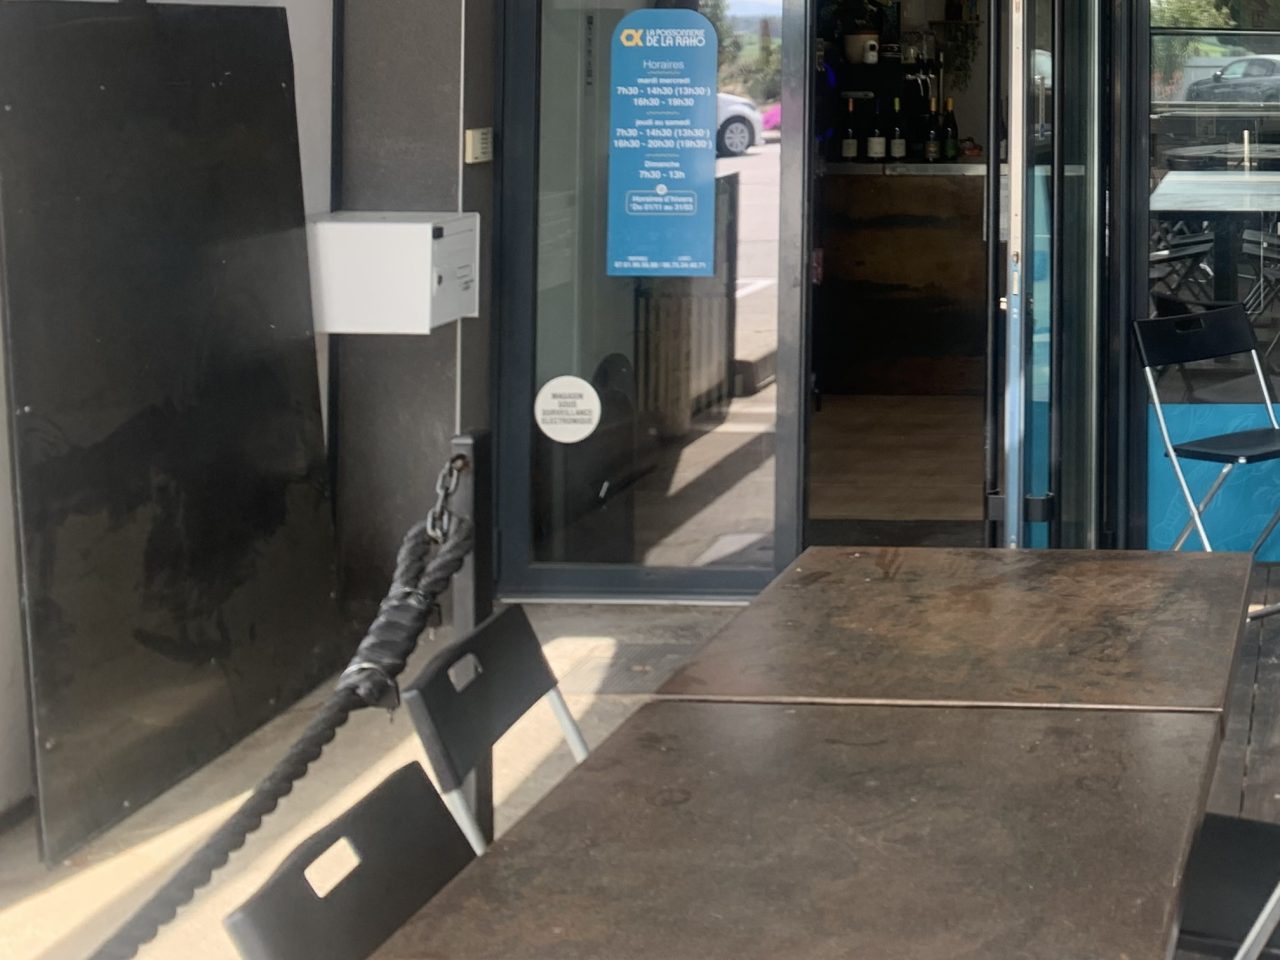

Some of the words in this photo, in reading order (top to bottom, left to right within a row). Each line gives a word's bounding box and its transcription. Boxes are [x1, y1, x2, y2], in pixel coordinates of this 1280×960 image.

[646, 36, 660, 47] DE
[661, 36, 673, 47] LA
[675, 36, 706, 47] RAHO
[643, 59, 685, 69] Horaires
[616, 86, 639, 95] 7h30
[647, 86, 673, 95] 14h30
[646, 128, 673, 137] 14h30
